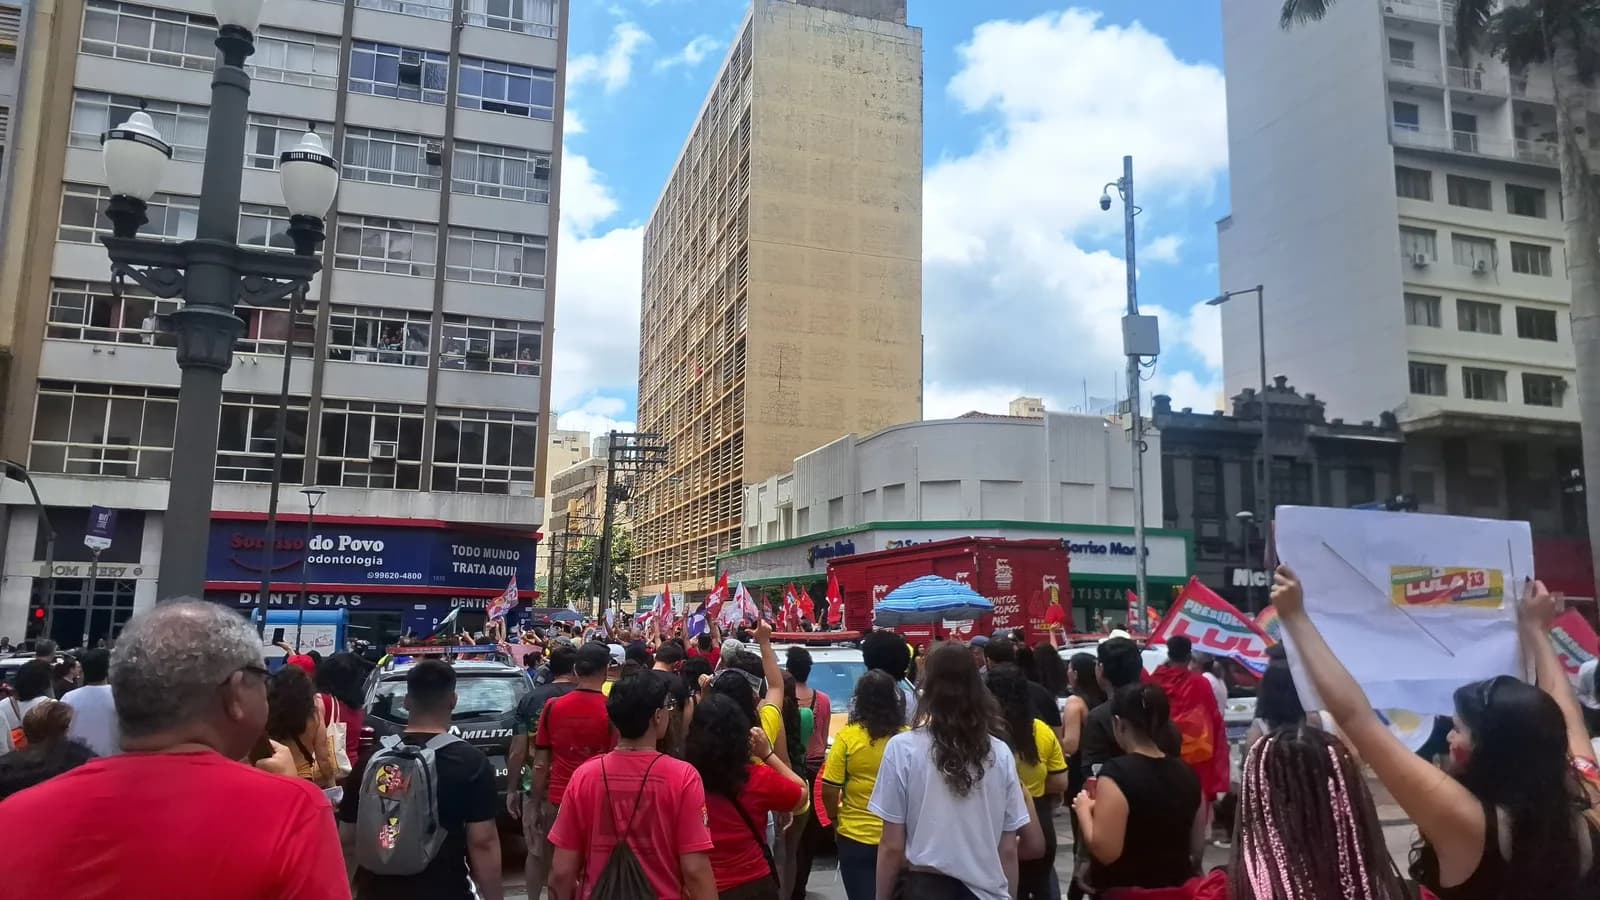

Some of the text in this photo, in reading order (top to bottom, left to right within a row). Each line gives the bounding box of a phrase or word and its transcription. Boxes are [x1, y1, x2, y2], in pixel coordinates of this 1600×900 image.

[231, 533, 384, 552] Soriso do Povo
[452, 544, 520, 561] TODO MUNDO
[308, 554, 383, 567] odontologia
[374, 571, 422, 581] 99620-4800
[452, 562, 487, 575] TRATA
[1406, 575, 1464, 596] LULA
[1467, 571, 1485, 588] 13
[239, 592, 361, 606] DNTSTAS
[1171, 618, 1264, 658] LUL
